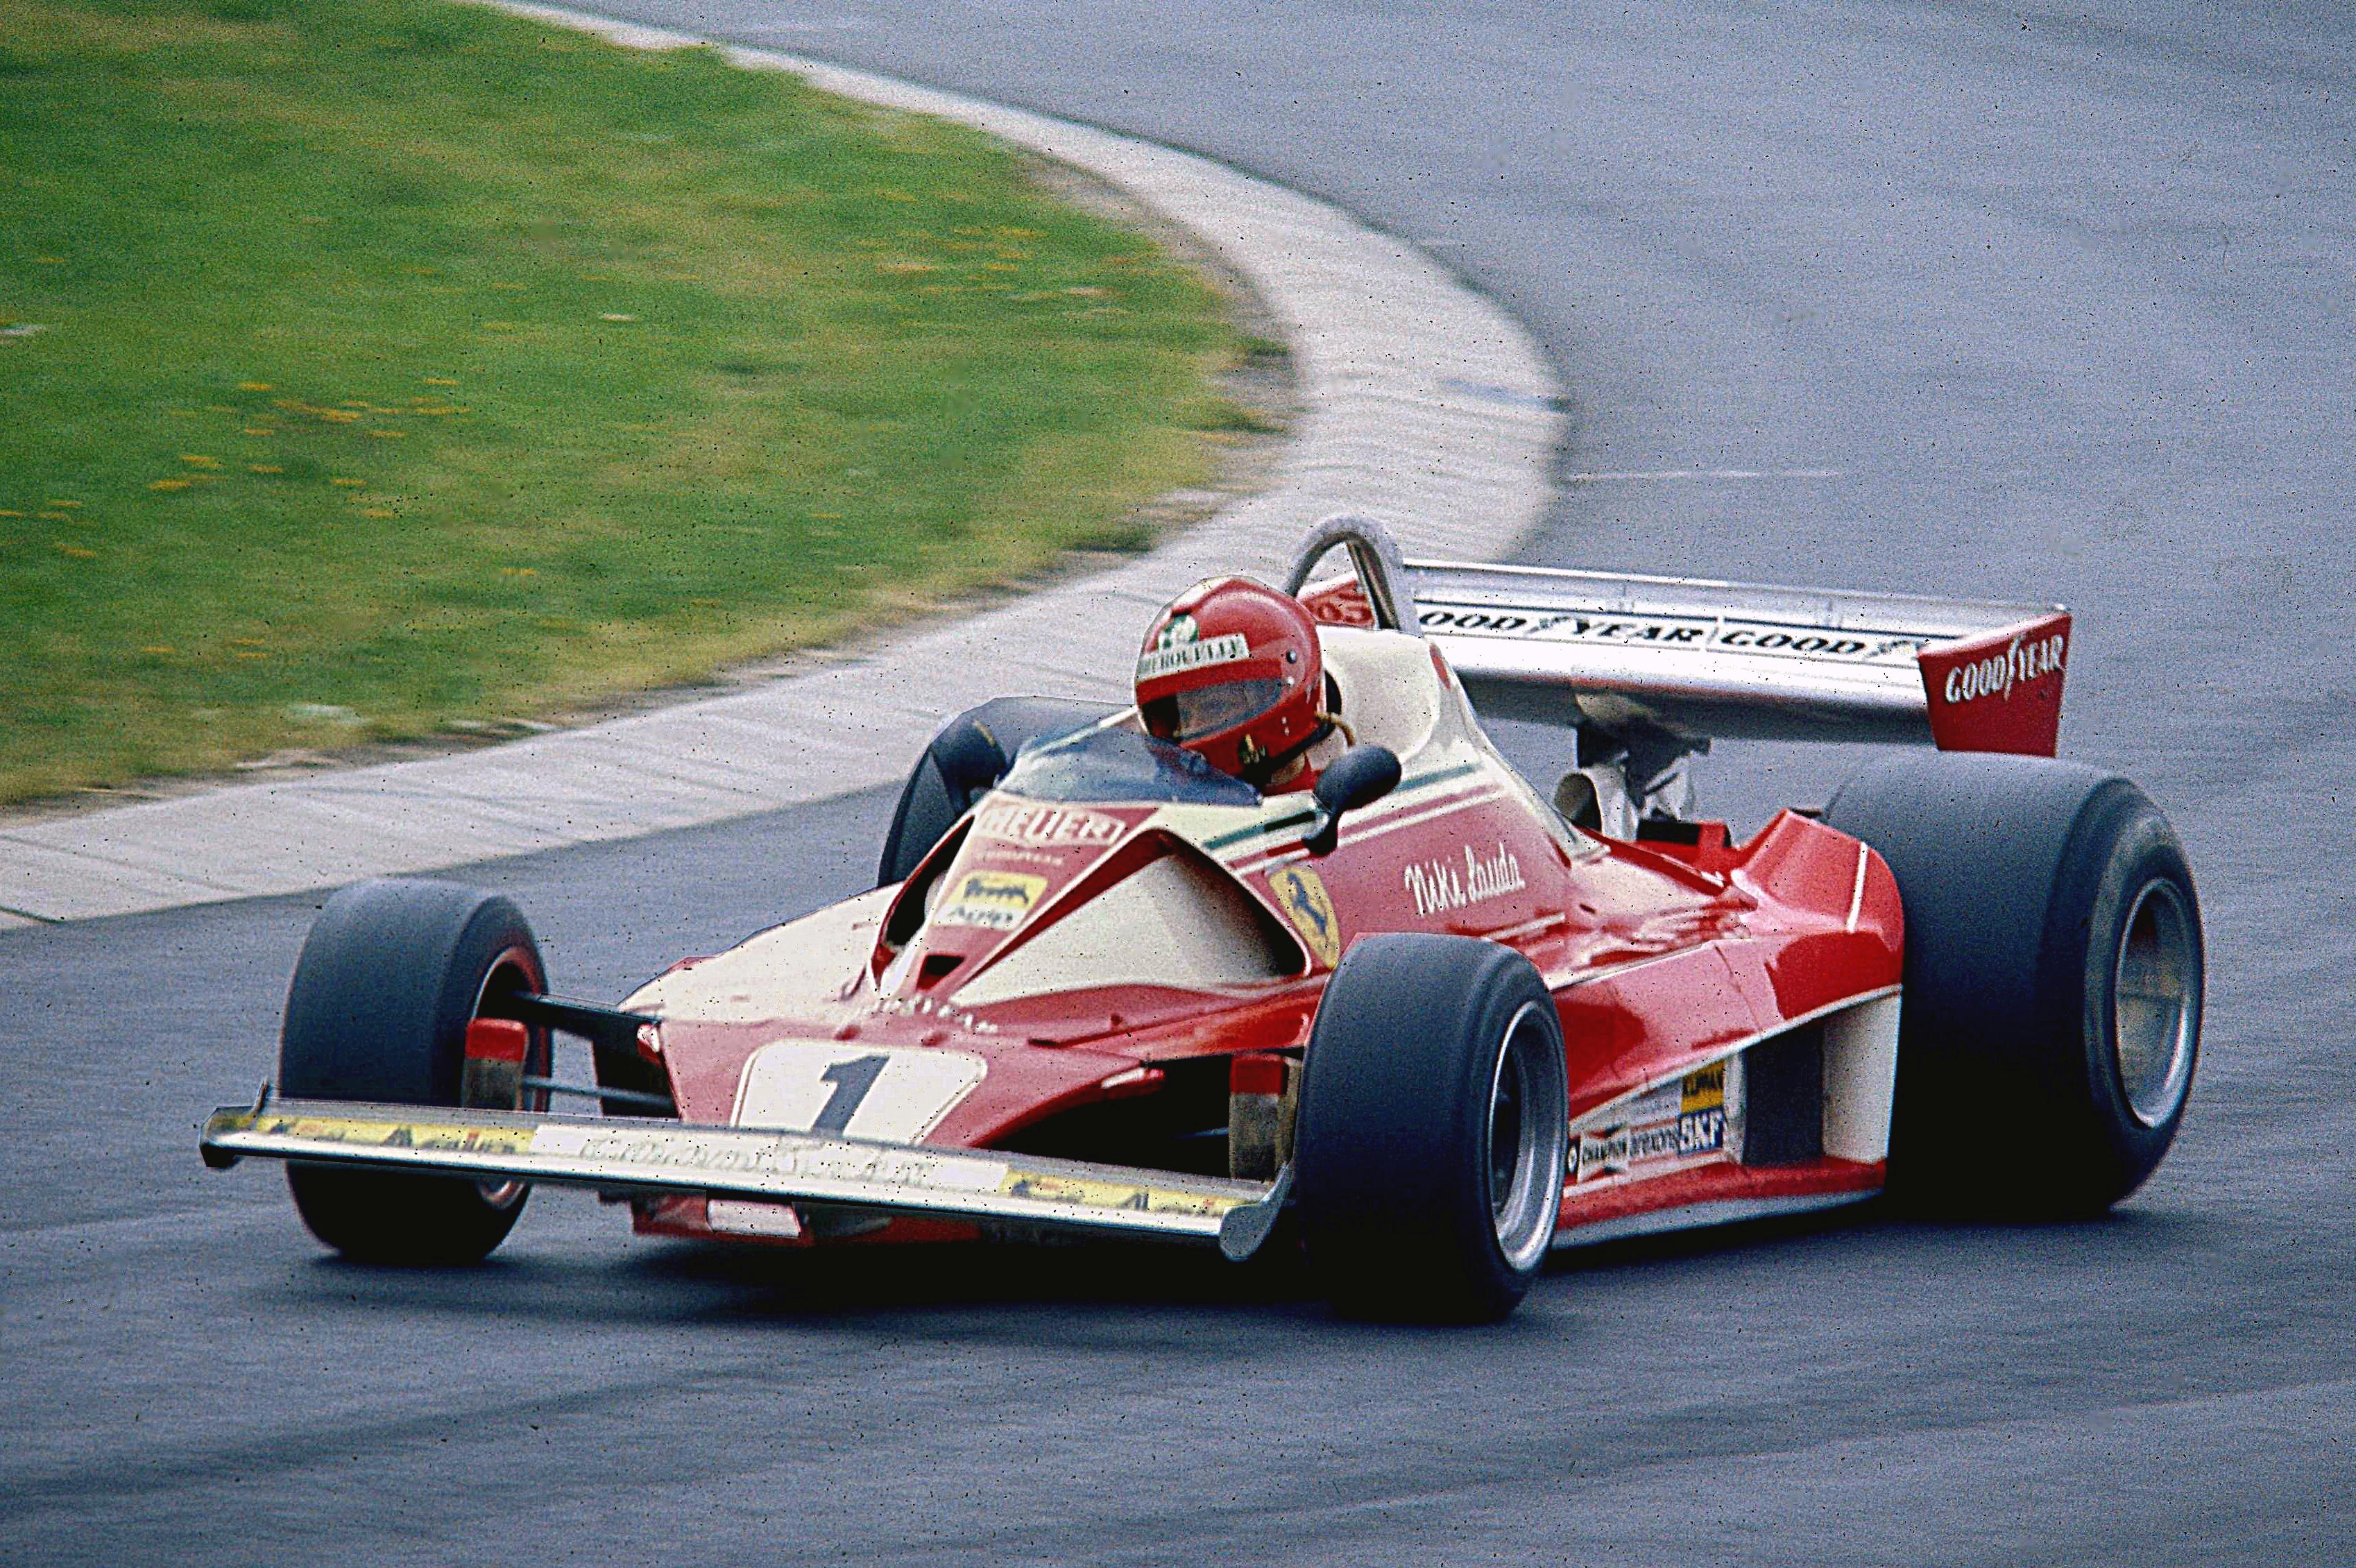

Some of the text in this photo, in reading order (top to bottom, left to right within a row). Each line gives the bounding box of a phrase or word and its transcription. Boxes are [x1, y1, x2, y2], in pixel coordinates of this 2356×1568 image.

[1945, 633, 2063, 703] GOODYEAR
[1404, 841, 1525, 917] Niki Lauda
[810, 1054, 890, 1136] 1
[1680, 1110, 1723, 1150] SKF
